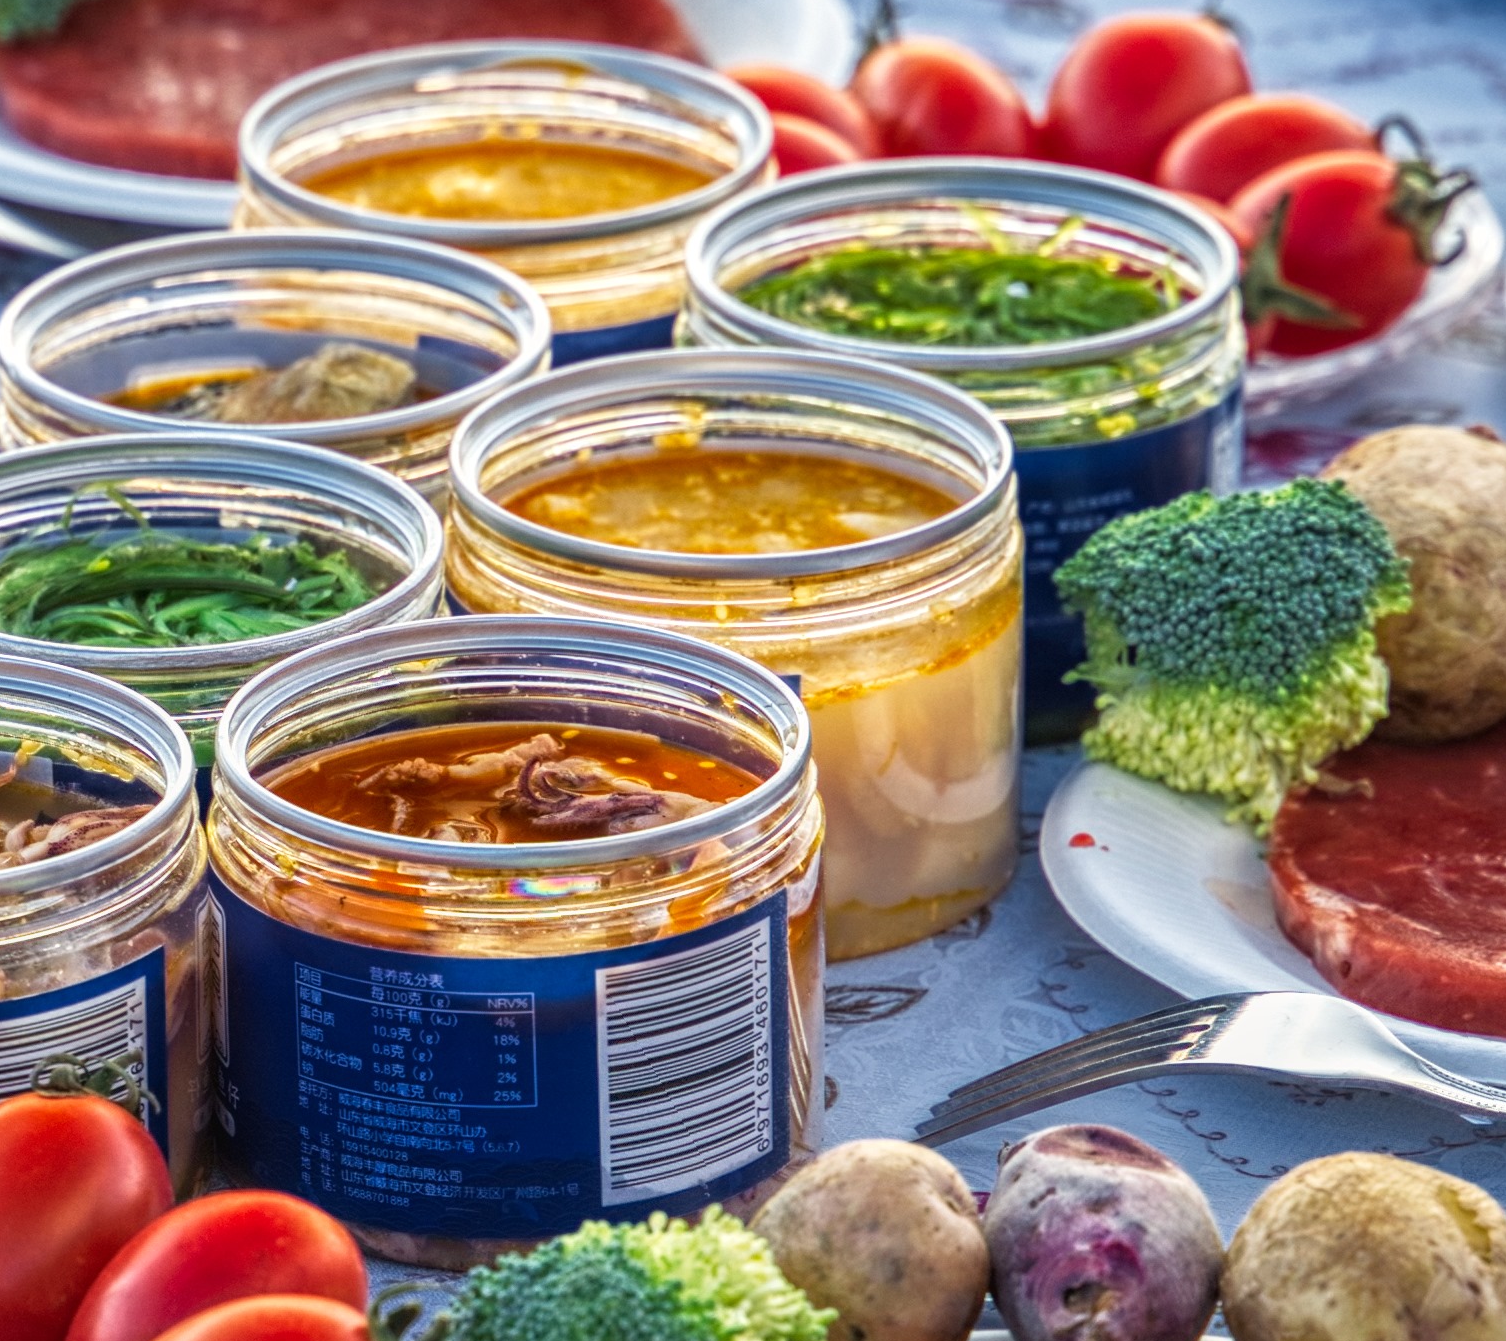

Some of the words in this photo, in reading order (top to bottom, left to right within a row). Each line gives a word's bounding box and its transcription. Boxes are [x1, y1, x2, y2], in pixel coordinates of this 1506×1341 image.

[299, 967, 322, 986] 项目
[487, 998, 528, 1009] NRV%
[369, 967, 444, 989] 营养成分表
[299, 986, 322, 1005] 能量
[495, 1017, 515, 1028] 4%
[299, 1004, 335, 1027] 蛋白质
[493, 1035, 520, 1046] 18%
[300, 1022, 324, 1042] 脂肪
[498, 1054, 517, 1064] 1%
[301, 1041, 363, 1071] 碳水化合物
[497, 1072, 517, 1084] 2%
[302, 1061, 314, 1076] 钠
[494, 1090, 521, 1102] 25%
